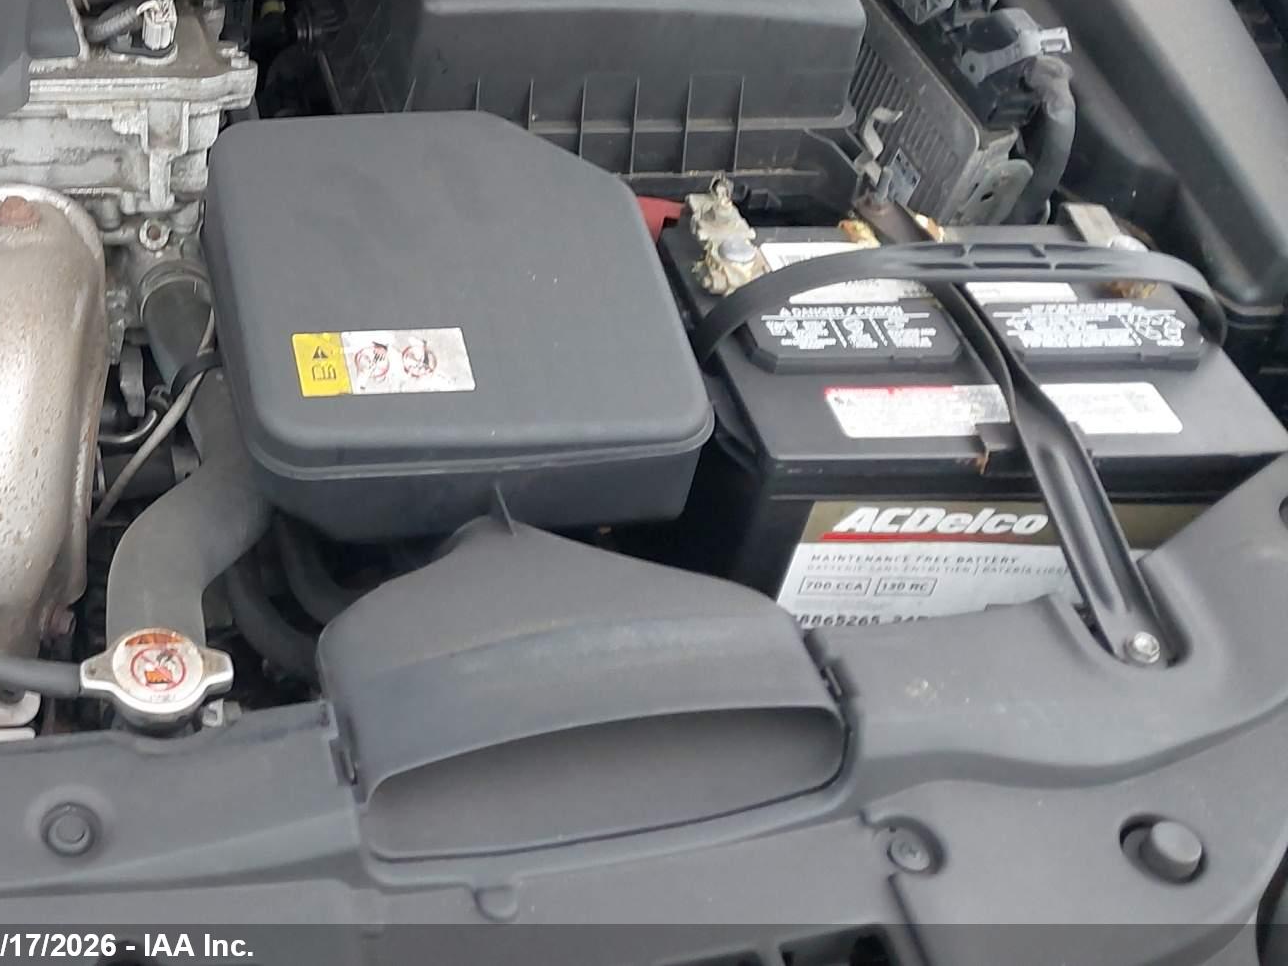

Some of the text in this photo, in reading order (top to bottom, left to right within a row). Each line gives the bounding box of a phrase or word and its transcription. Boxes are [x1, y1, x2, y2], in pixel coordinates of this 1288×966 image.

[831, 506, 1048, 535] ACDelco
[811, 553, 1019, 564] MAINTENANCE FREE BATTERY
[835, 581, 864, 591] CCA
